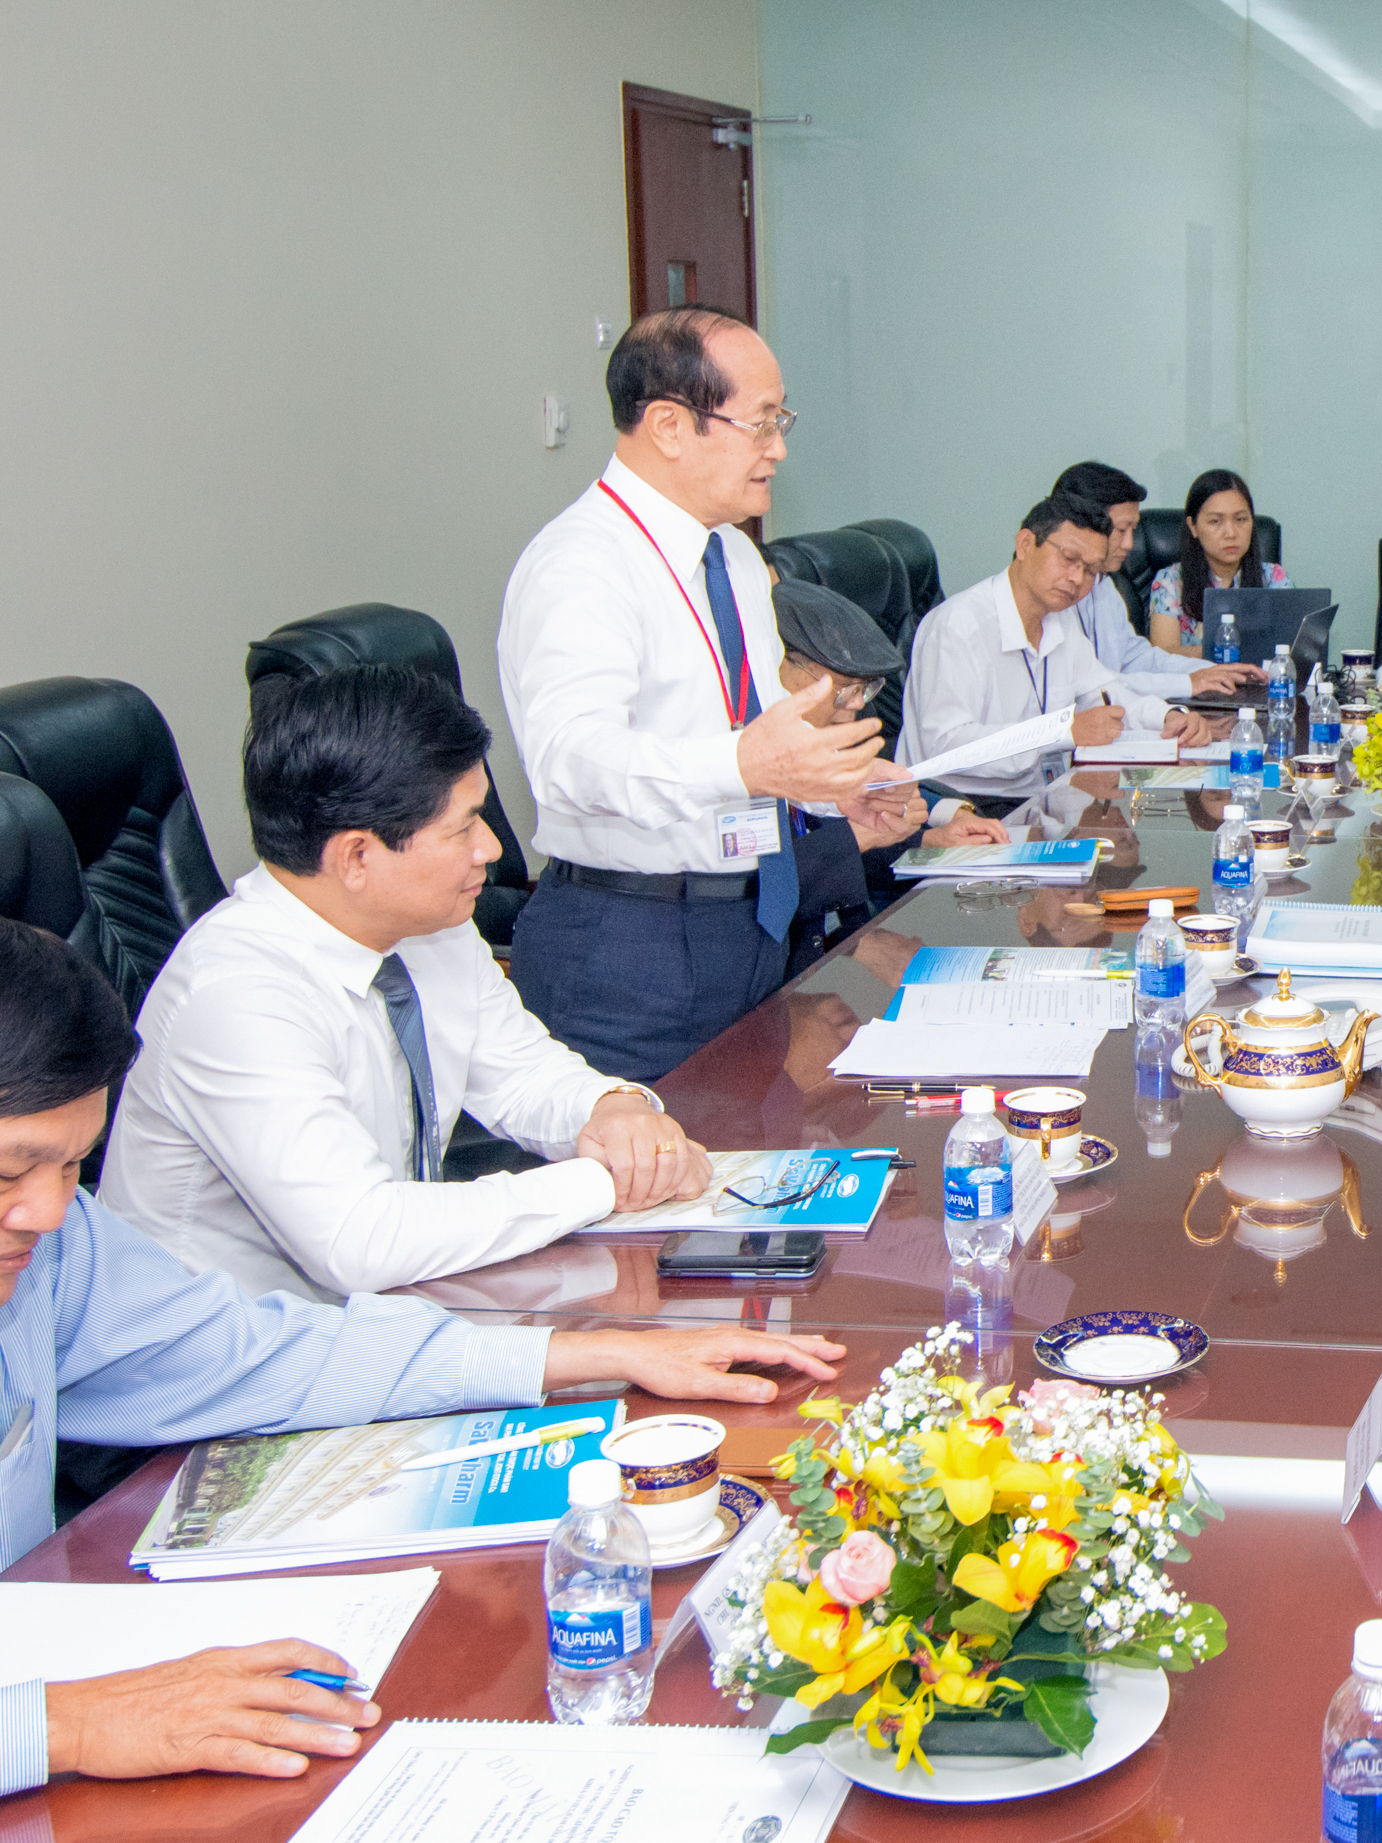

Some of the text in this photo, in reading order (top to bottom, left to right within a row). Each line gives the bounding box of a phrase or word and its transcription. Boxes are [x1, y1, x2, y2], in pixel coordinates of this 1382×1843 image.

[1220, 870, 1248, 879] AQUAFINA
[945, 1191, 975, 1208] QUAFINA
[450, 1421, 496, 1504] SaVharm
[552, 1626, 618, 1648] AQUAFINA
[596, 1655, 617, 1665] pepsi
